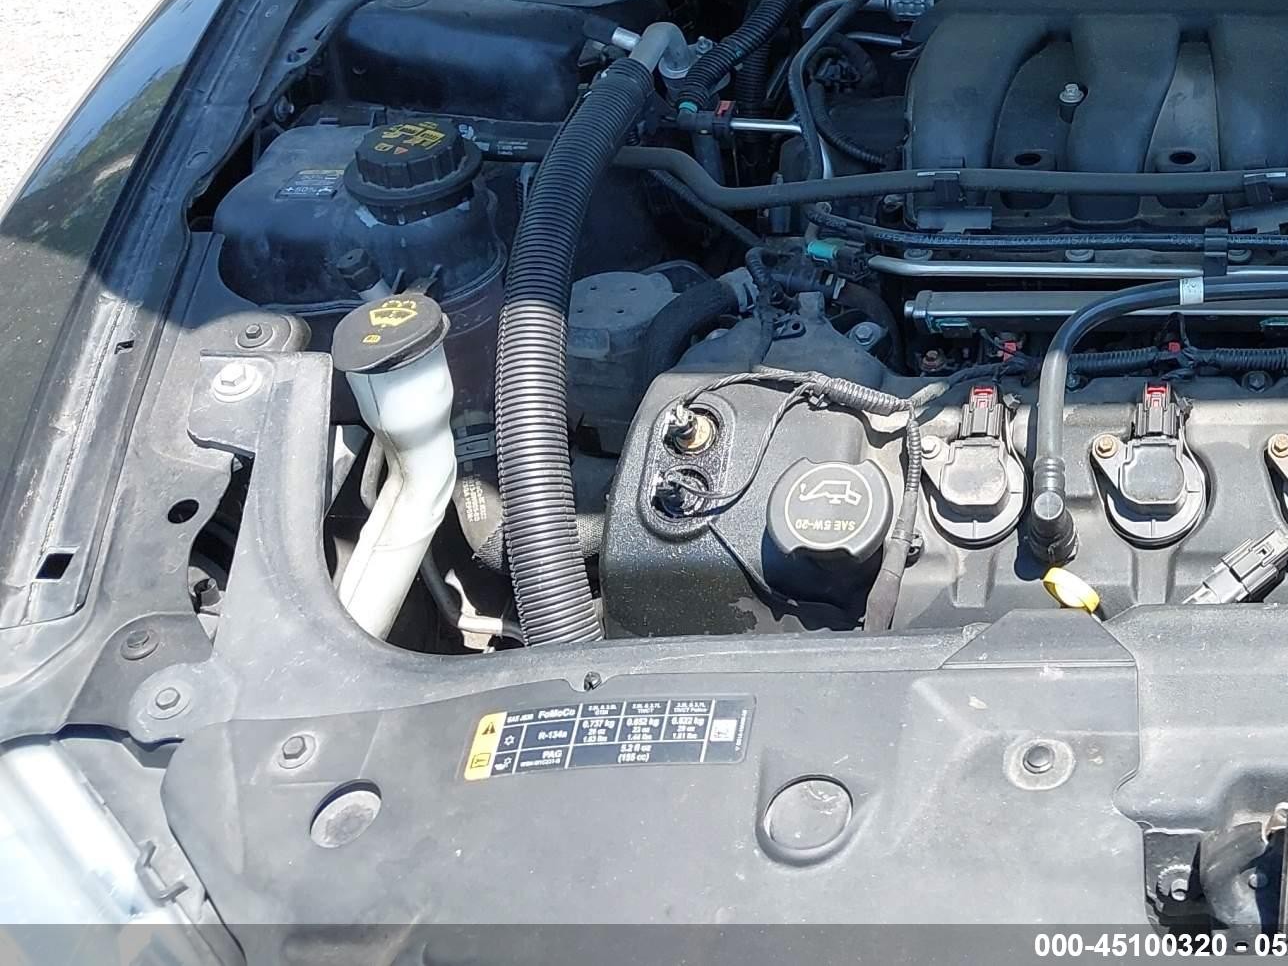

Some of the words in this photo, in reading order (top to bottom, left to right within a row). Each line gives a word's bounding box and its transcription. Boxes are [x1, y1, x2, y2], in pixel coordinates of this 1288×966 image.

[795, 519, 832, 531] 5W-20
[834, 520, 857, 531] SAE
[538, 708, 576, 720] FoMoCo
[538, 729, 568, 740] R-134a
[542, 749, 563, 759] PAG
